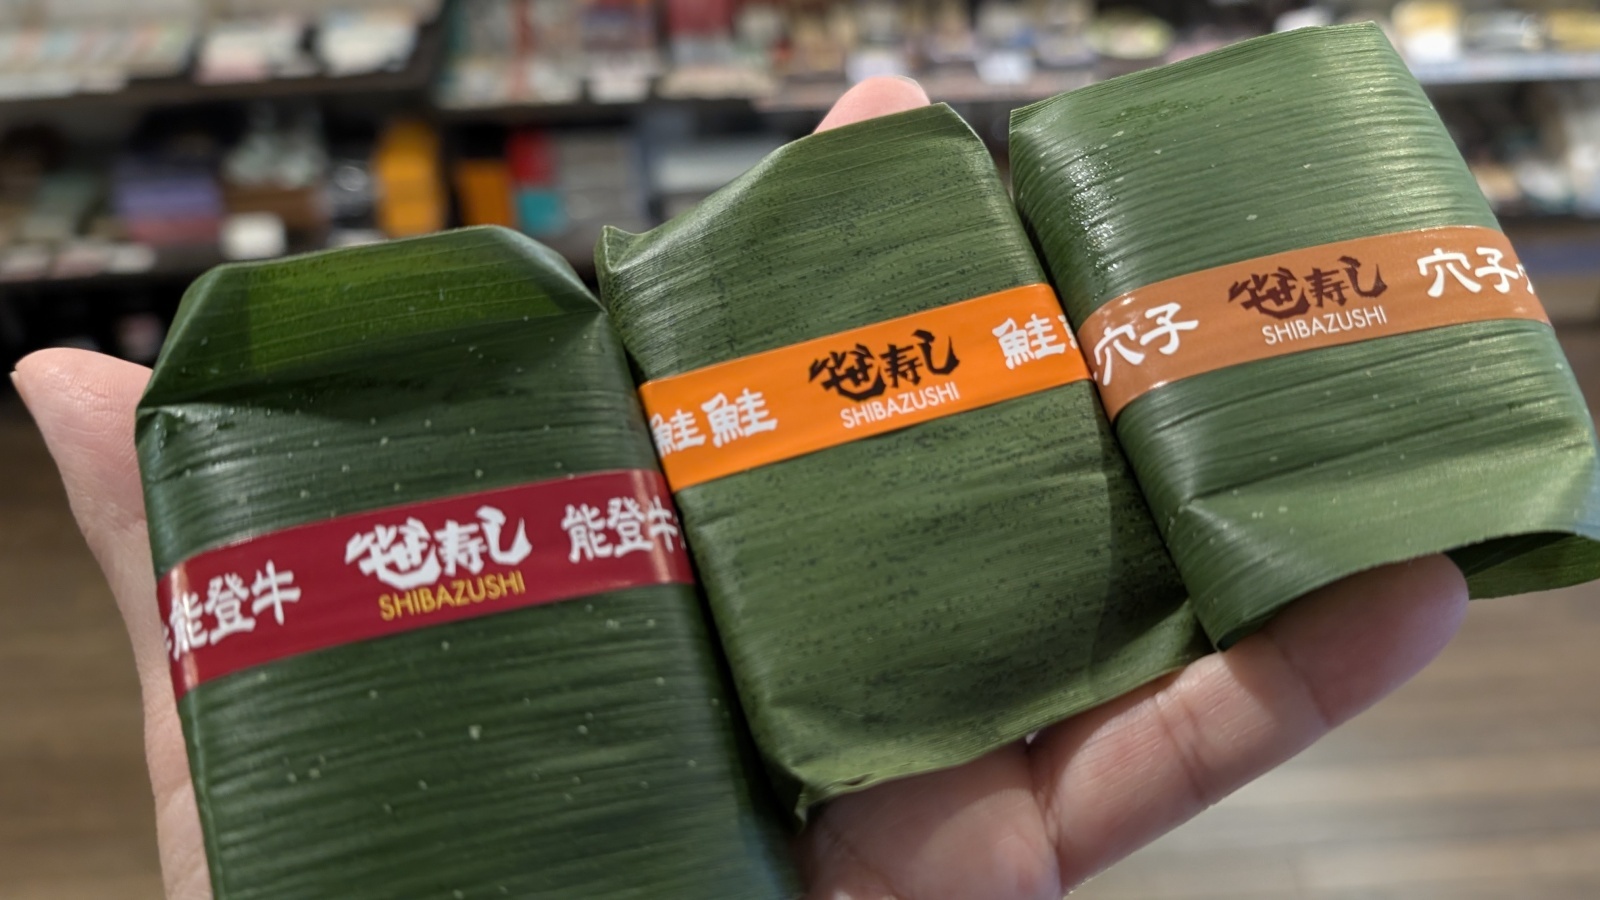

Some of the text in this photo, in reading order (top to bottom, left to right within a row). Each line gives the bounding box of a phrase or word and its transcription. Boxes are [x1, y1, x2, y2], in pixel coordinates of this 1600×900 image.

[1093, 302, 1199, 386] 穴子
[1416, 246, 1519, 298] 穴子
[1261, 304, 1388, 345] SHIBAZUSHI
[839, 381, 960, 429] SHIBAZUSHI
[168, 558, 302, 662] 能登牛
[560, 495, 679, 563] 能登牛
[378, 570, 526, 621] SHIBAZUSHI
